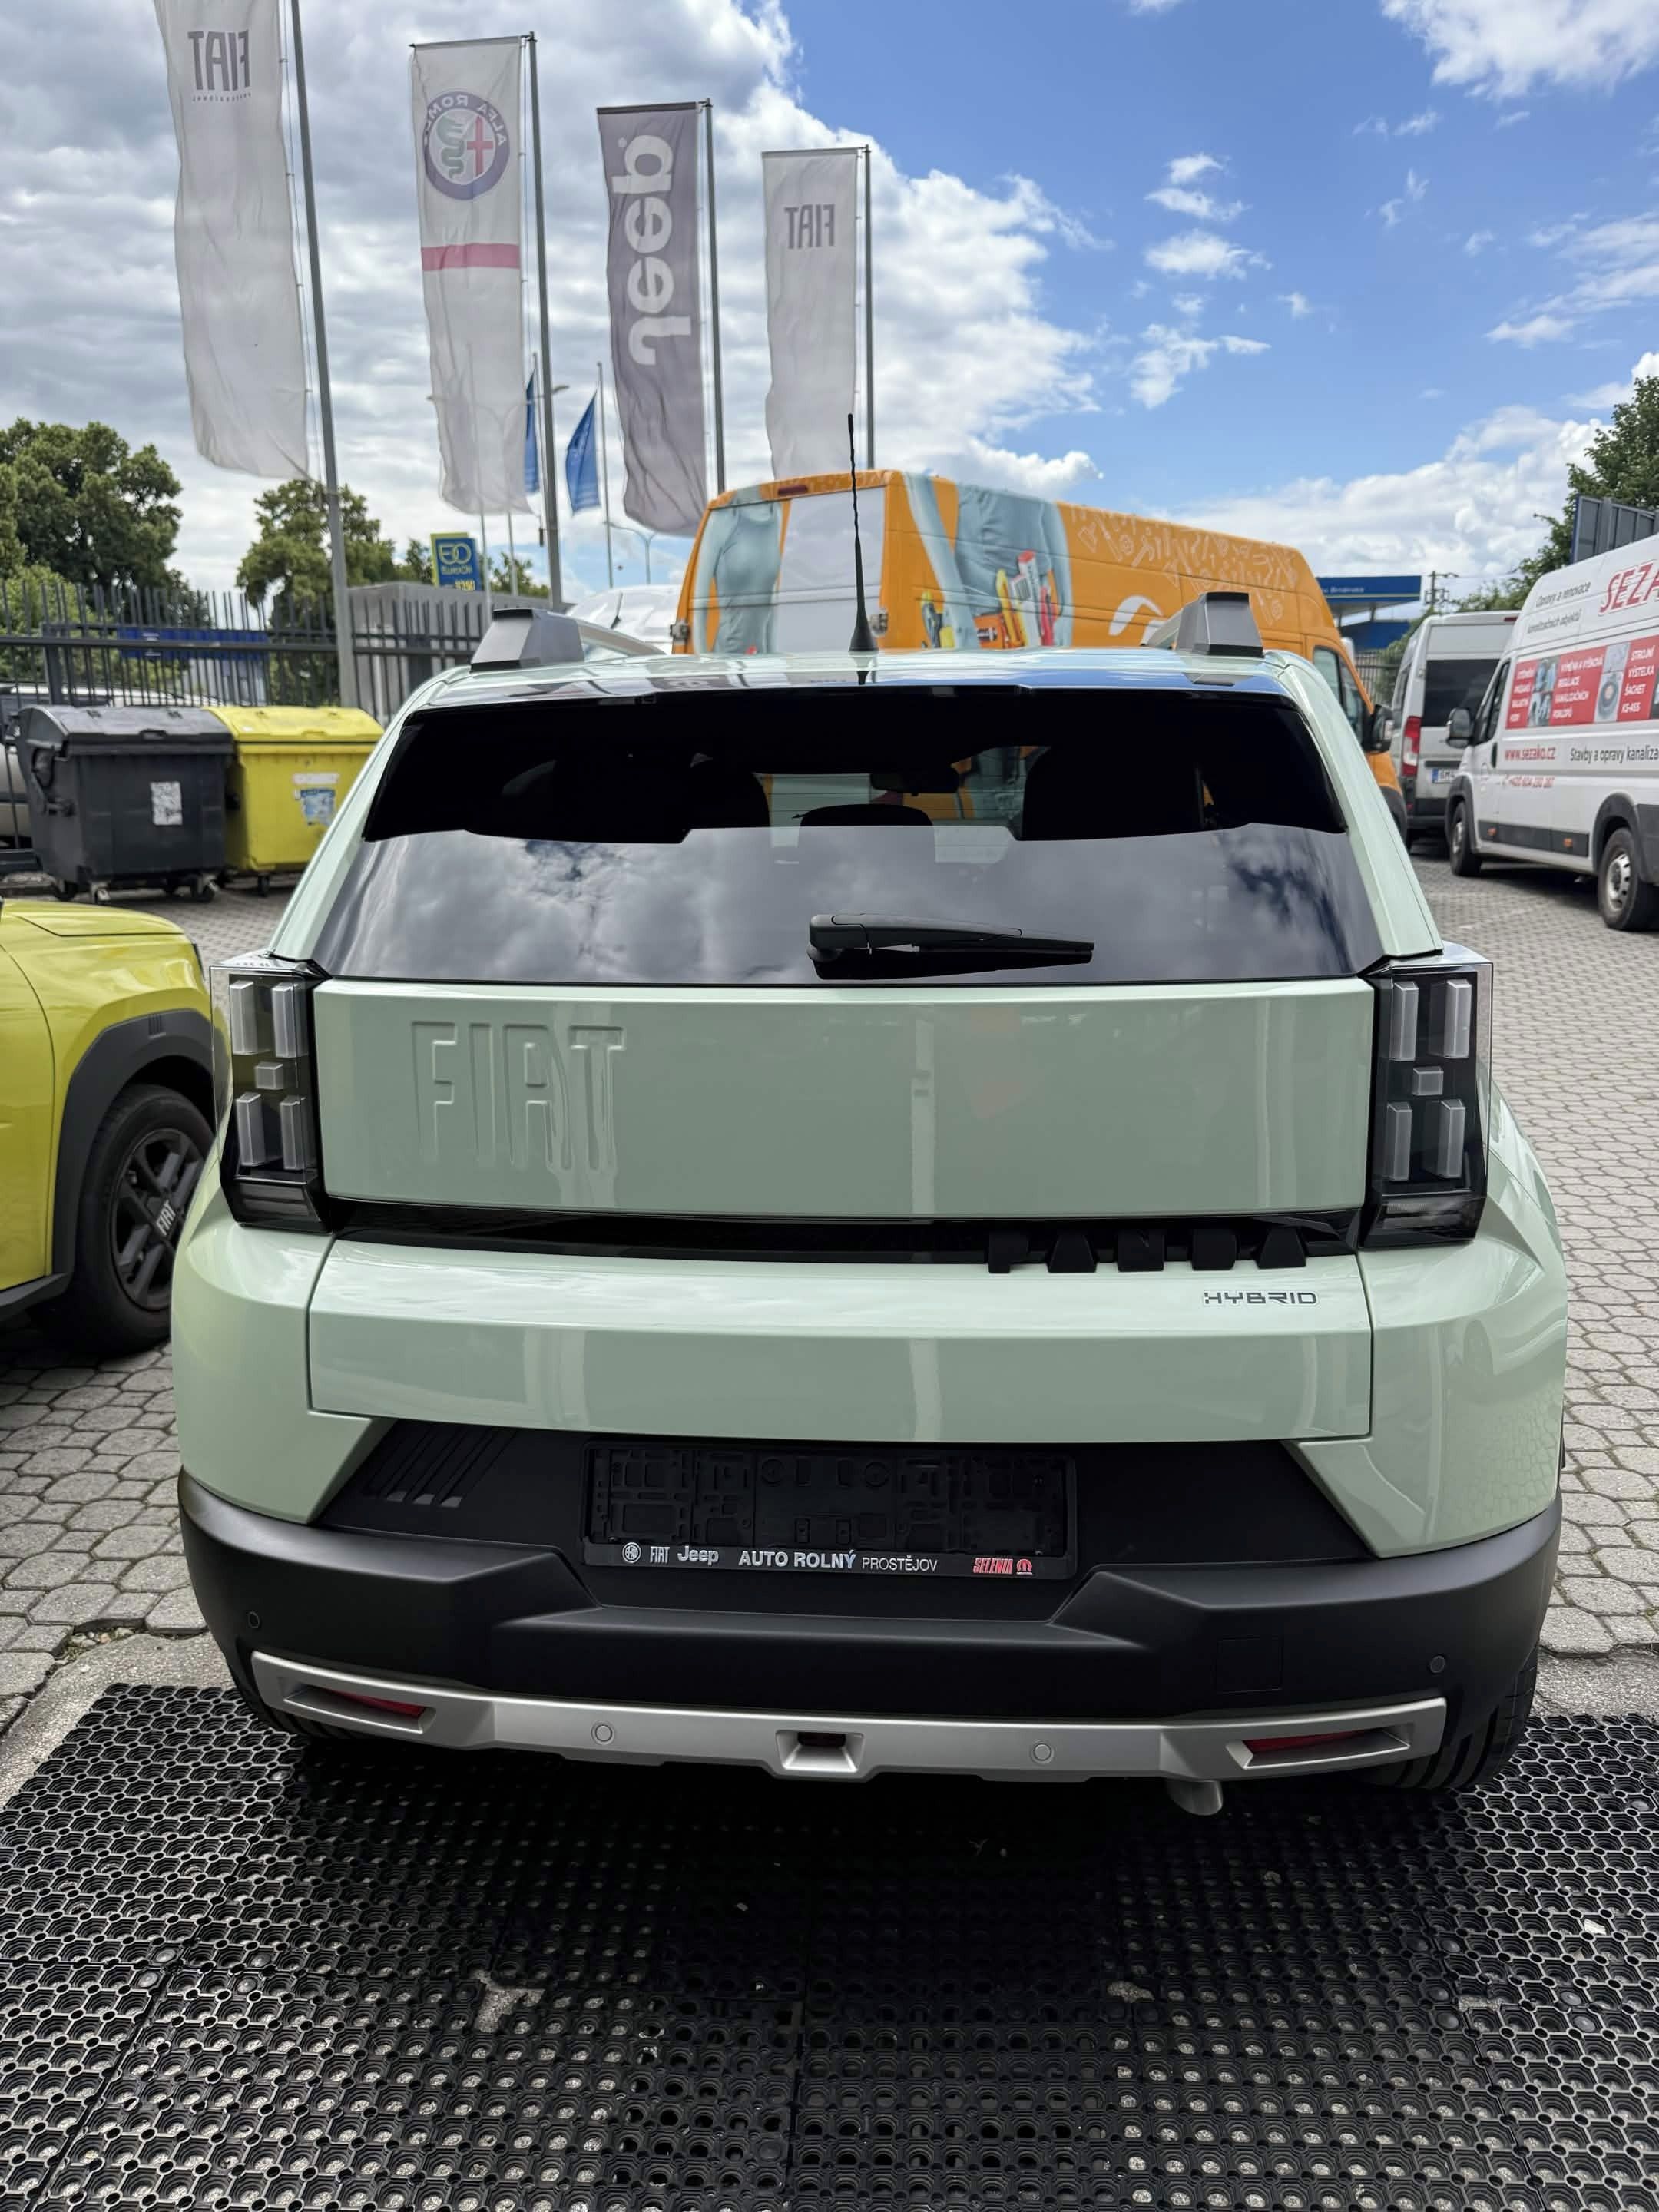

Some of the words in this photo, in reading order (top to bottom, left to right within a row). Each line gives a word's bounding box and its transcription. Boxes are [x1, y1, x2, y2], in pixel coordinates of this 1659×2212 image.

[1504, 743, 1557, 762] www.sezako.cz
[1570, 746, 1594, 764] Stavby
[1594, 749, 1599, 762] a
[1599, 748, 1626, 764] opravy
[410, 1019, 627, 1171] FIAT
[156, 1199, 177, 1236] FIAT
[1204, 1292, 1317, 1305] HYBRID
[649, 1545, 671, 1564] FIAT
[677, 1545, 720, 1567] Jeep
[738, 1550, 789, 1568] AUTO
[793, 1549, 856, 1569] ROLNÝ
[862, 1555, 939, 1572] PROSTĚJOV
[972, 1557, 1014, 1575] SELENIA
